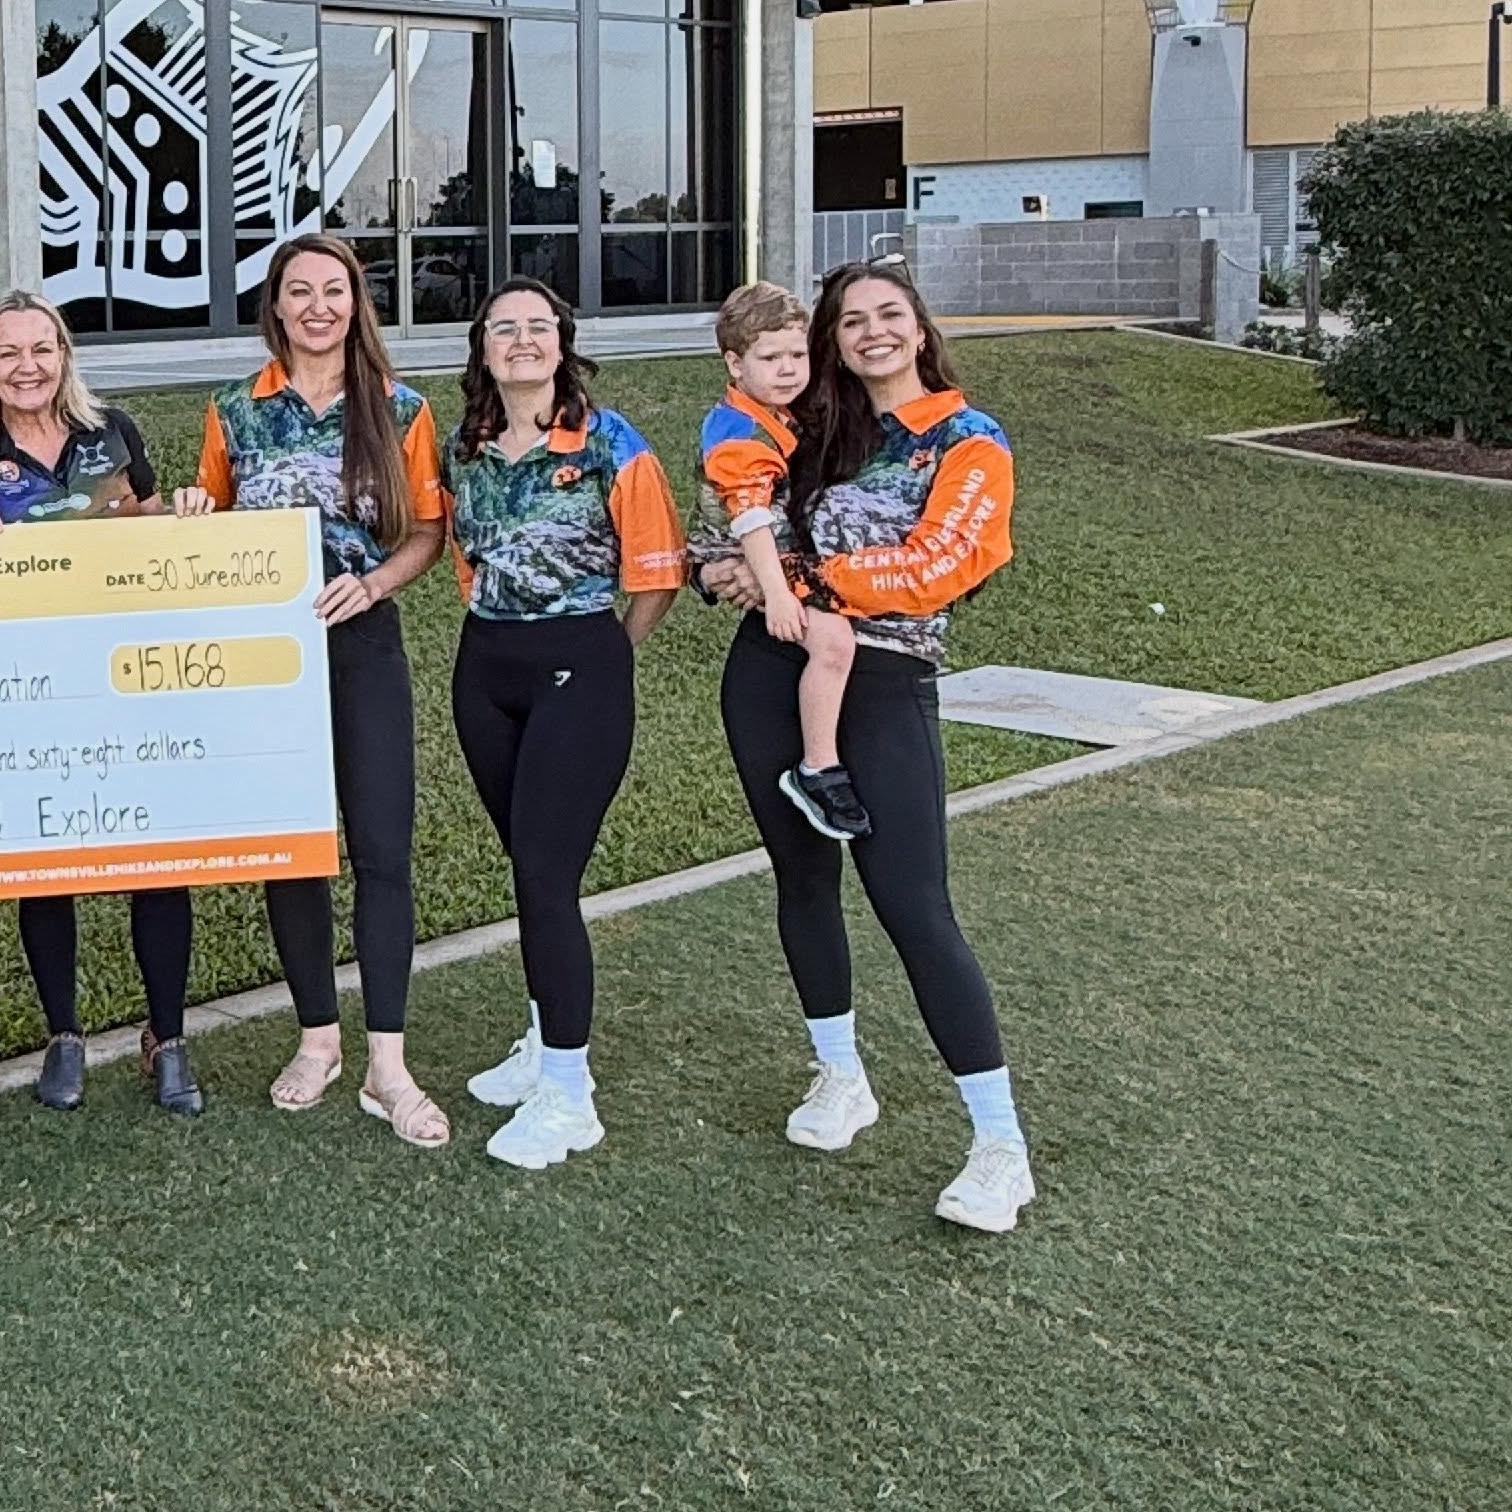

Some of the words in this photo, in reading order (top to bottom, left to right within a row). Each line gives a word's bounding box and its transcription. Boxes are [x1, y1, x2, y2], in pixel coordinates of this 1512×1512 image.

[106, 573, 145, 587] DATE
[147, 558, 178, 592] 30
[27, 734, 125, 781] sixty-eight
[137, 729, 206, 761] dollars
[38, 791, 150, 848] Explore
